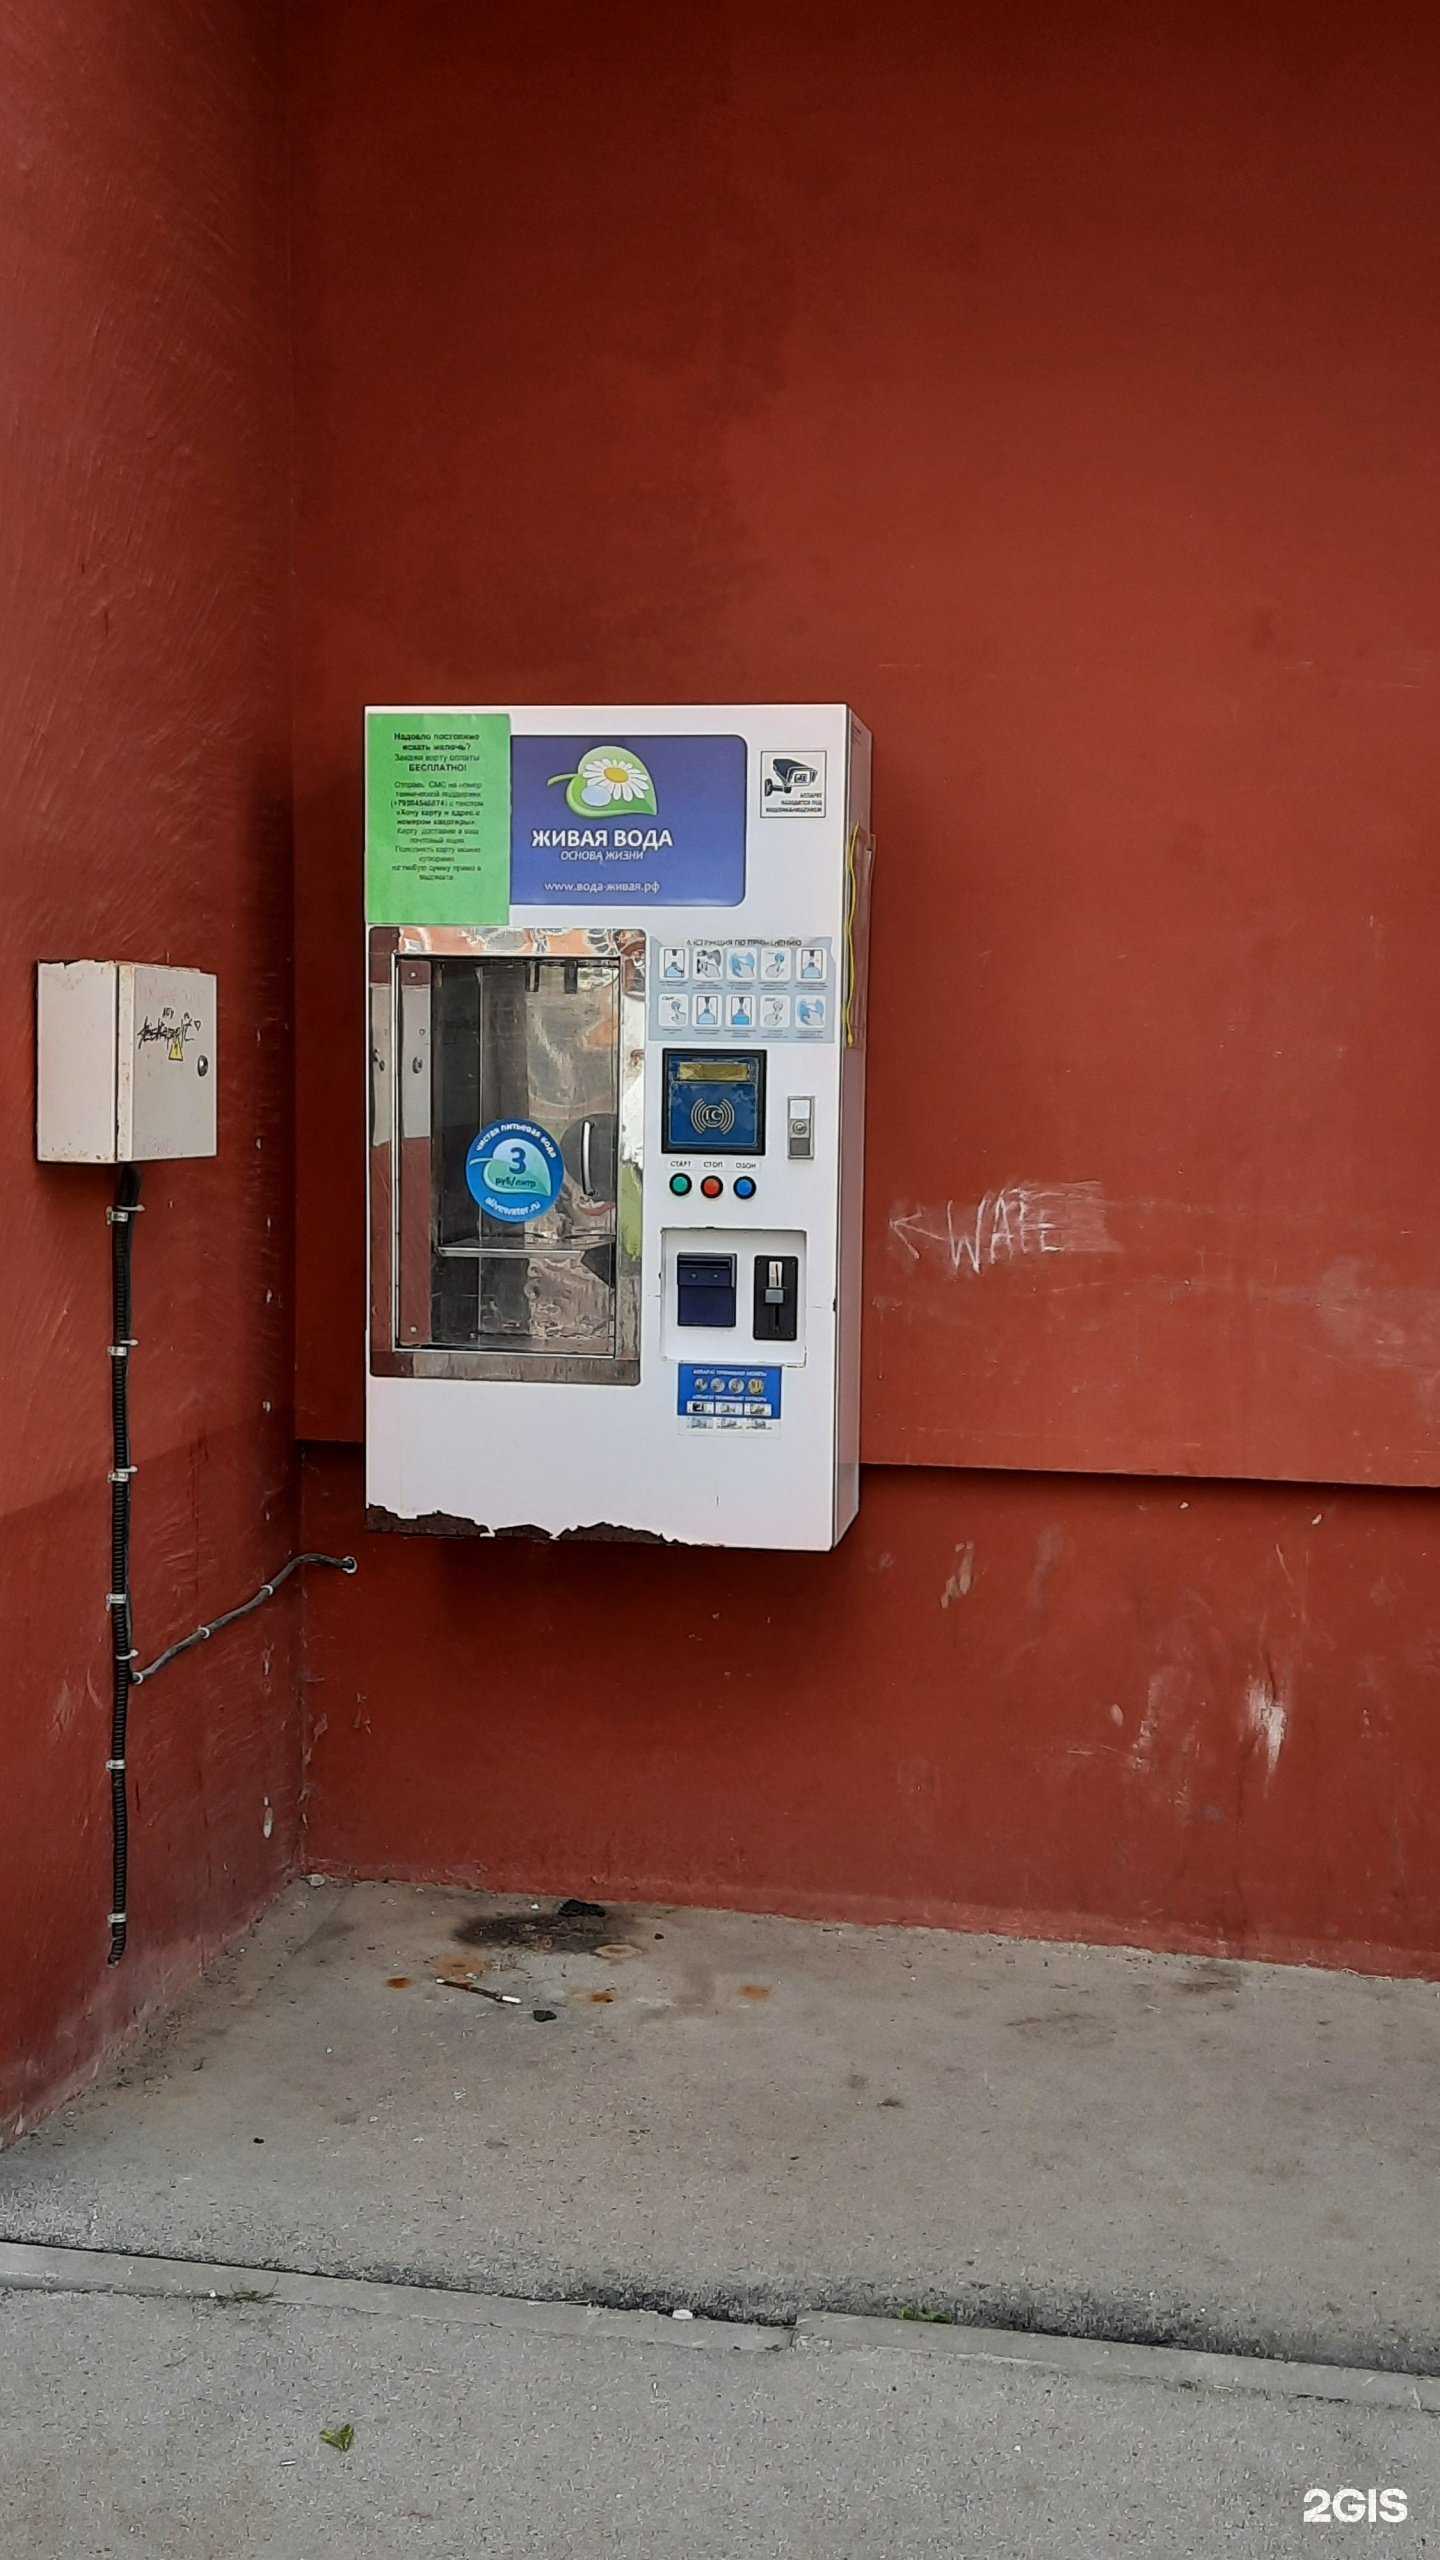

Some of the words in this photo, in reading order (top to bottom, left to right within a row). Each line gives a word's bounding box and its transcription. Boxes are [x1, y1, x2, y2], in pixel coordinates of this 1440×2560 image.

[408, 763, 467, 772] БЕСПЛАТНО!
[531, 829, 608, 847] ЖИВАЯ
[613, 829, 673, 851] ВОДА
[560, 851, 604, 861] ОСНОВА
[605, 851, 645, 861] ЖИЗНИ
[544, 881, 660, 893] www.вода-живая.рф
[508, 1146, 526, 1175] 3
[670, 1160, 691, 1168] СТАРТ
[703, 1161, 723, 1169] СТОП
